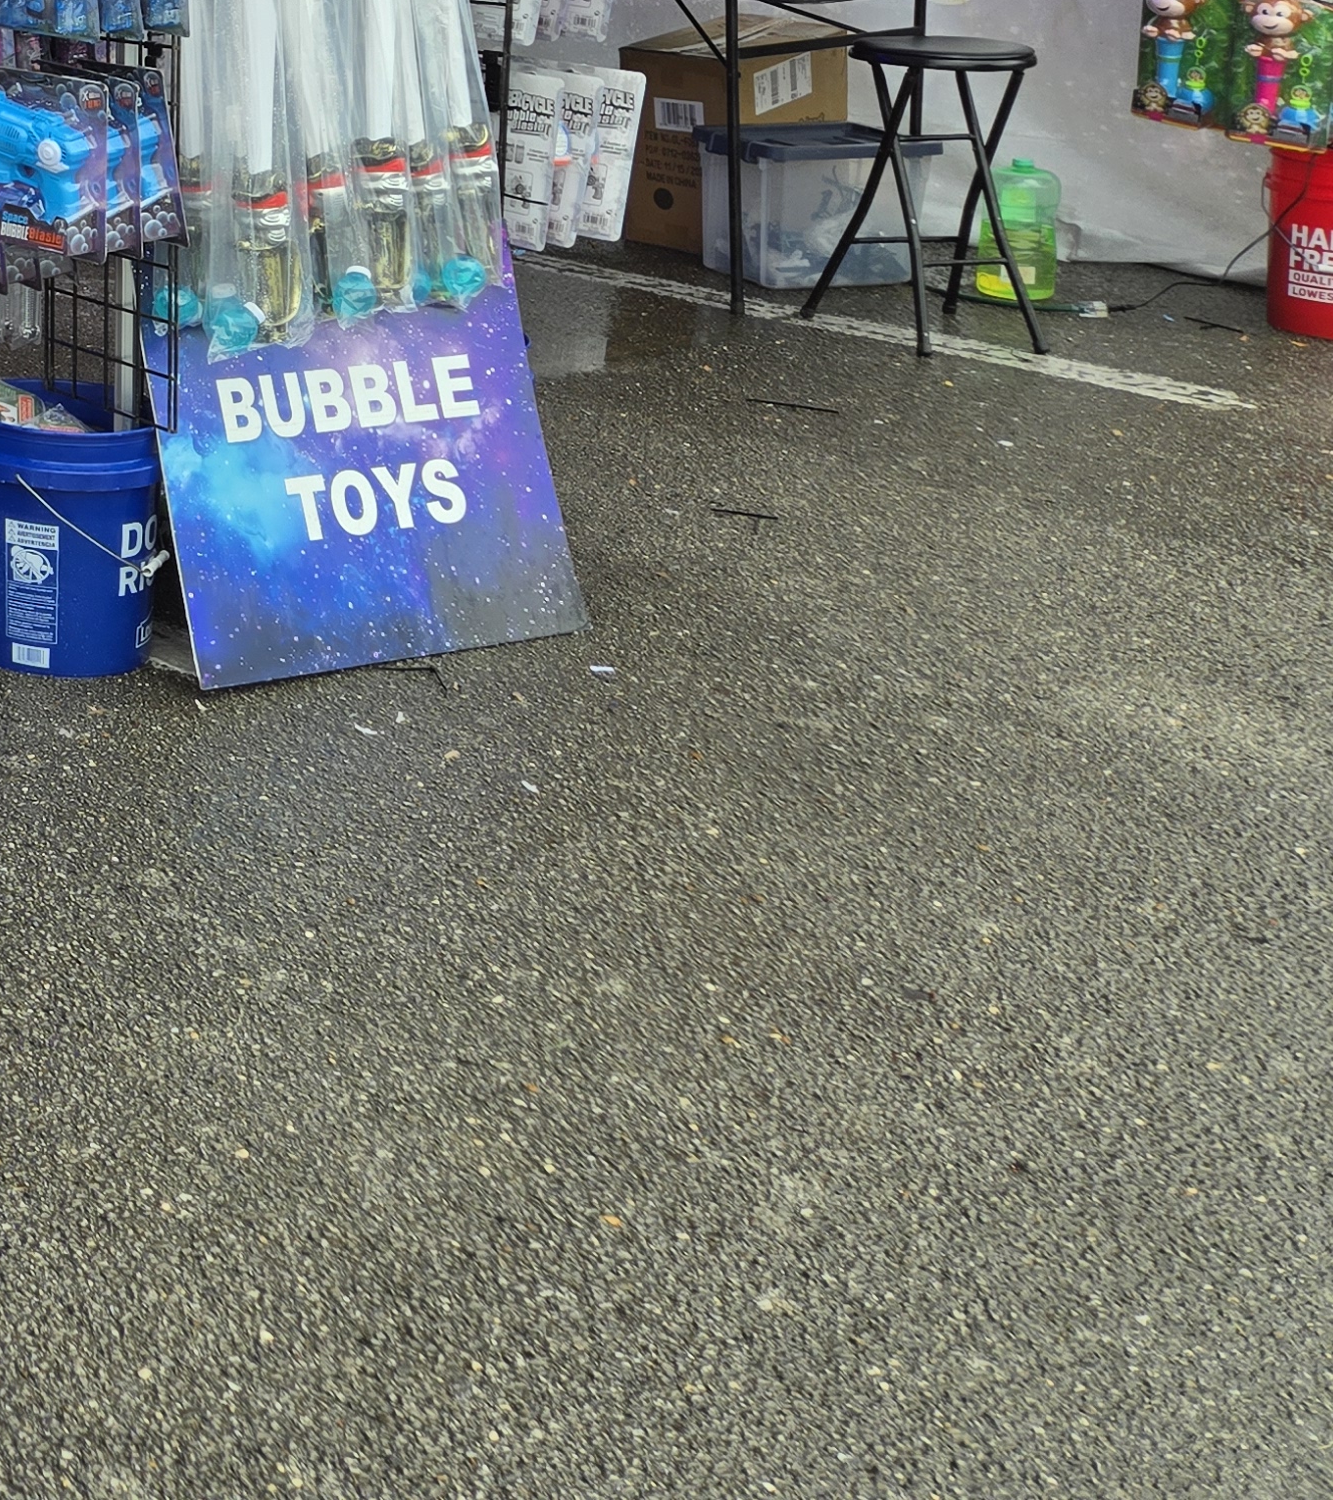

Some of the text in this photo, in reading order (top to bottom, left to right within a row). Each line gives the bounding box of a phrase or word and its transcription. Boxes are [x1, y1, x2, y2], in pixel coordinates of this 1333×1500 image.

[2, 211, 28, 225] Space
[0, 223, 29, 241] BUBBLE
[1291, 223, 1333, 251] HA
[217, 353, 481, 444] BUBBLE
[285, 458, 467, 541] TOYS
[17, 523, 57, 534] WARNING
